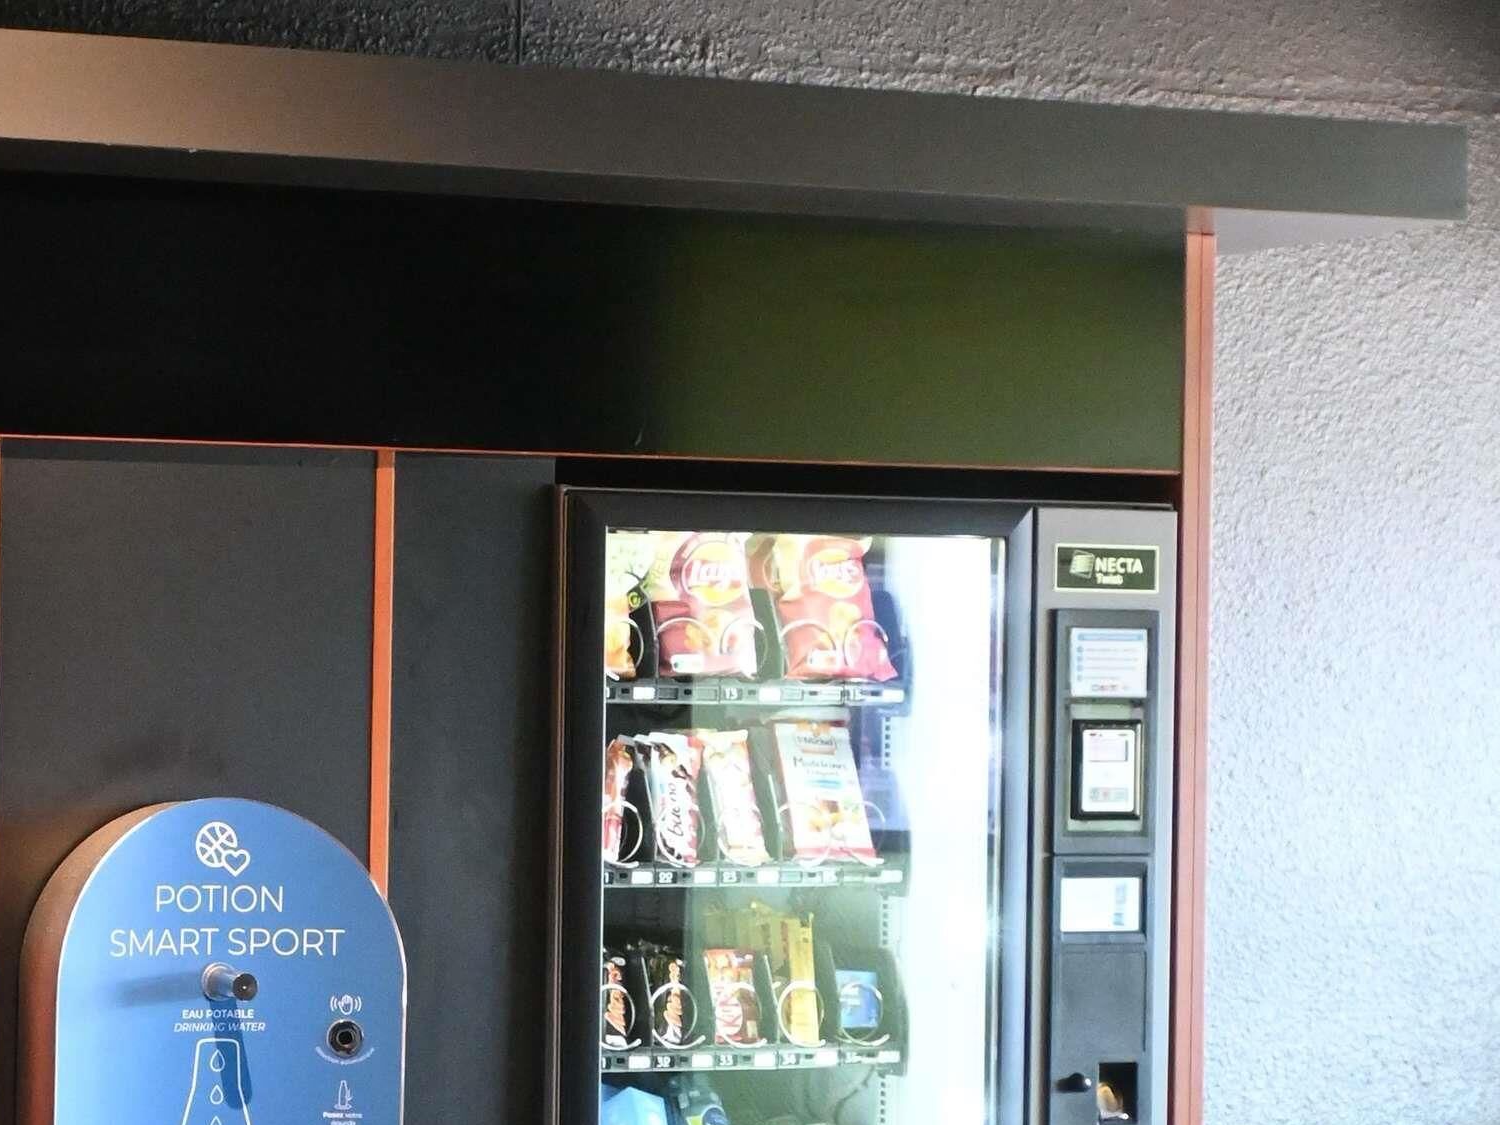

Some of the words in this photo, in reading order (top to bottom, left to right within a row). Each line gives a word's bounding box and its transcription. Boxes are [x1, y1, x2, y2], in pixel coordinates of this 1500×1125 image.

[1095, 557, 1143, 574] NECTA
[156, 885, 284, 912] POTION
[109, 928, 220, 957] SMART
[228, 928, 345, 956] SPORT
[182, 1009, 204, 1019] EAU
[207, 1009, 254, 1019] POTABLE
[175, 1023, 225, 1032] DRINKING
[228, 1023, 265, 1031] WATER
